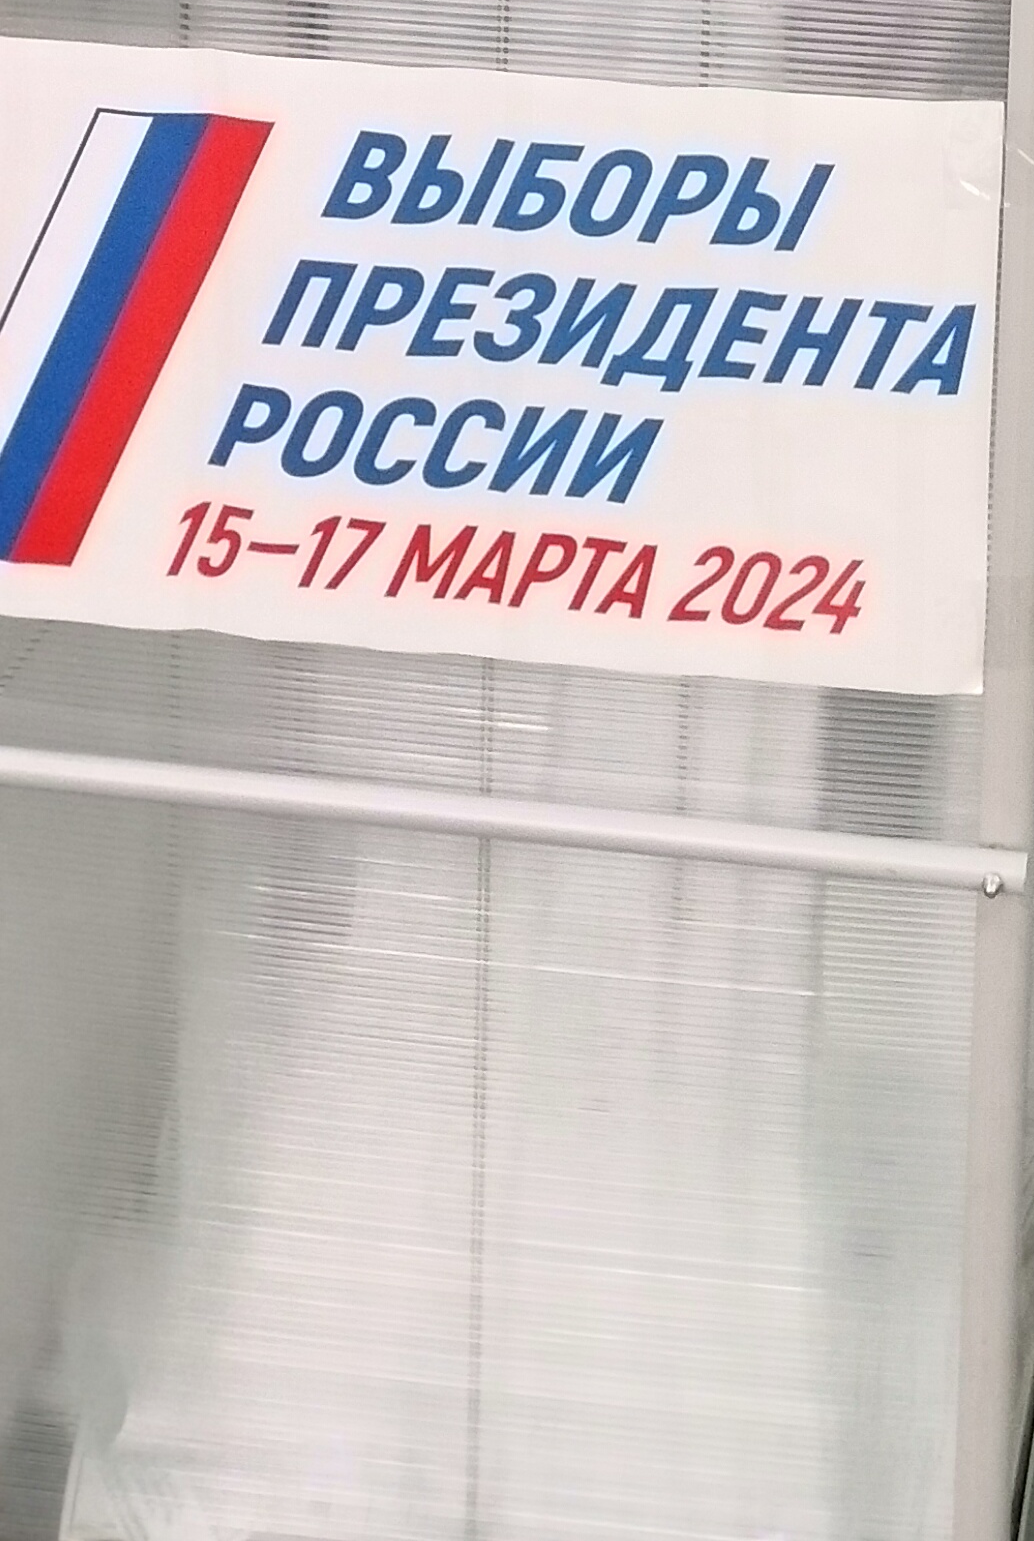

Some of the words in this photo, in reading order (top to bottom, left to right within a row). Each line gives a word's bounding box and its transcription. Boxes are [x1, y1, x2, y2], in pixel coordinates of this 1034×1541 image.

[322, 131, 834, 251] ВЫБОРЫ
[262, 259, 977, 396] ПРЕЗИДЕНТА
[209, 383, 664, 503] РОССИИ
[385, 523, 657, 619] МАРТА
[669, 545, 866, 636] 2024
